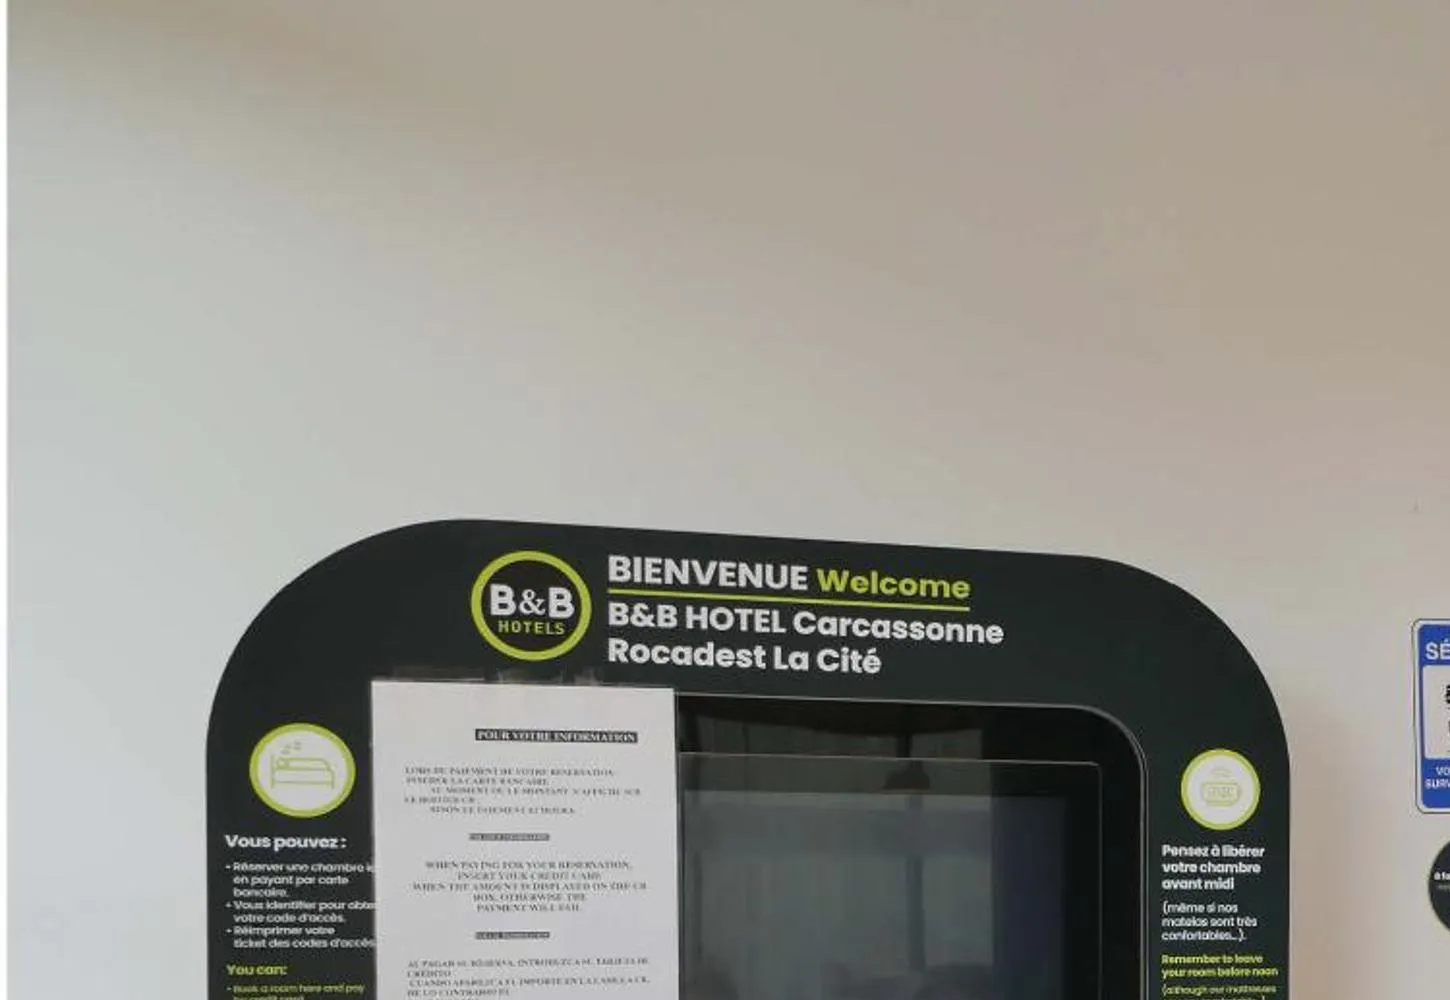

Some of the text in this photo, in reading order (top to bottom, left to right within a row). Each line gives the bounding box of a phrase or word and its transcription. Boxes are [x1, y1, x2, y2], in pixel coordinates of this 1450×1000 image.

[608, 555, 971, 599] BIENVENUE Welcome
[489, 586, 575, 619] B&B
[498, 621, 565, 637] HOTELS
[608, 602, 1004, 644] B&B HOTEL Carcassonne
[608, 637, 882, 673] Rocadest La Cité
[225, 835, 271, 847] Vous
[274, 837, 337, 852] pouvez
[1162, 844, 1265, 857] Pensez à libérer
[1162, 861, 1261, 873] votre chambre
[1162, 877, 1234, 890] avant midi
[226, 964, 254, 975] You
